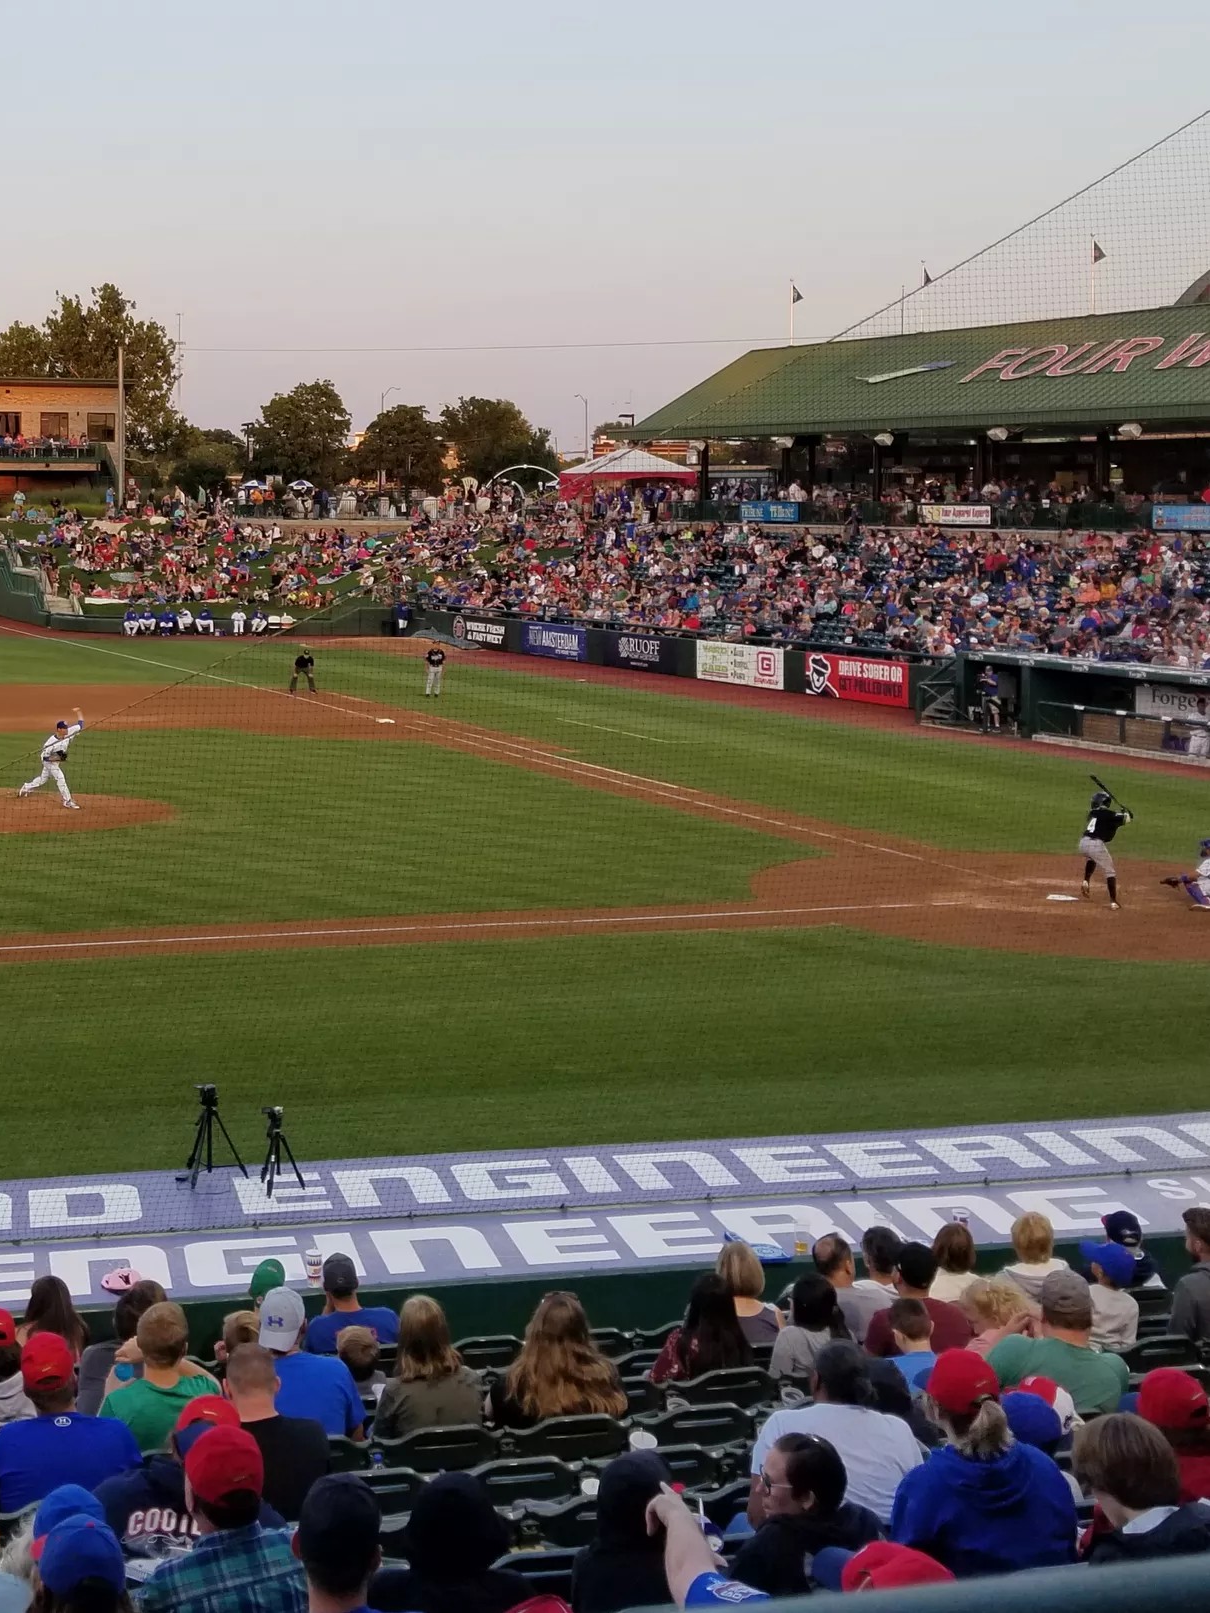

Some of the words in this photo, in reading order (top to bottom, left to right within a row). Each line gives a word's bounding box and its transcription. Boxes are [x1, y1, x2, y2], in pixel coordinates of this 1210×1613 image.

[957, 336, 1165, 384] FOUR
[466, 621, 486, 632] WHERE
[486, 624, 505, 635] FRESH
[472, 632, 487, 642] FAST
[487, 634, 503, 644] MEET
[542, 630, 579, 651] AMSTERDAM
[628, 637, 660, 654] RUOFF
[838, 660, 862, 678] DRIVE
[863, 663, 890, 681] SOBER
[890, 666, 903, 683] OR
[1151, 688, 1197, 711] Forge
